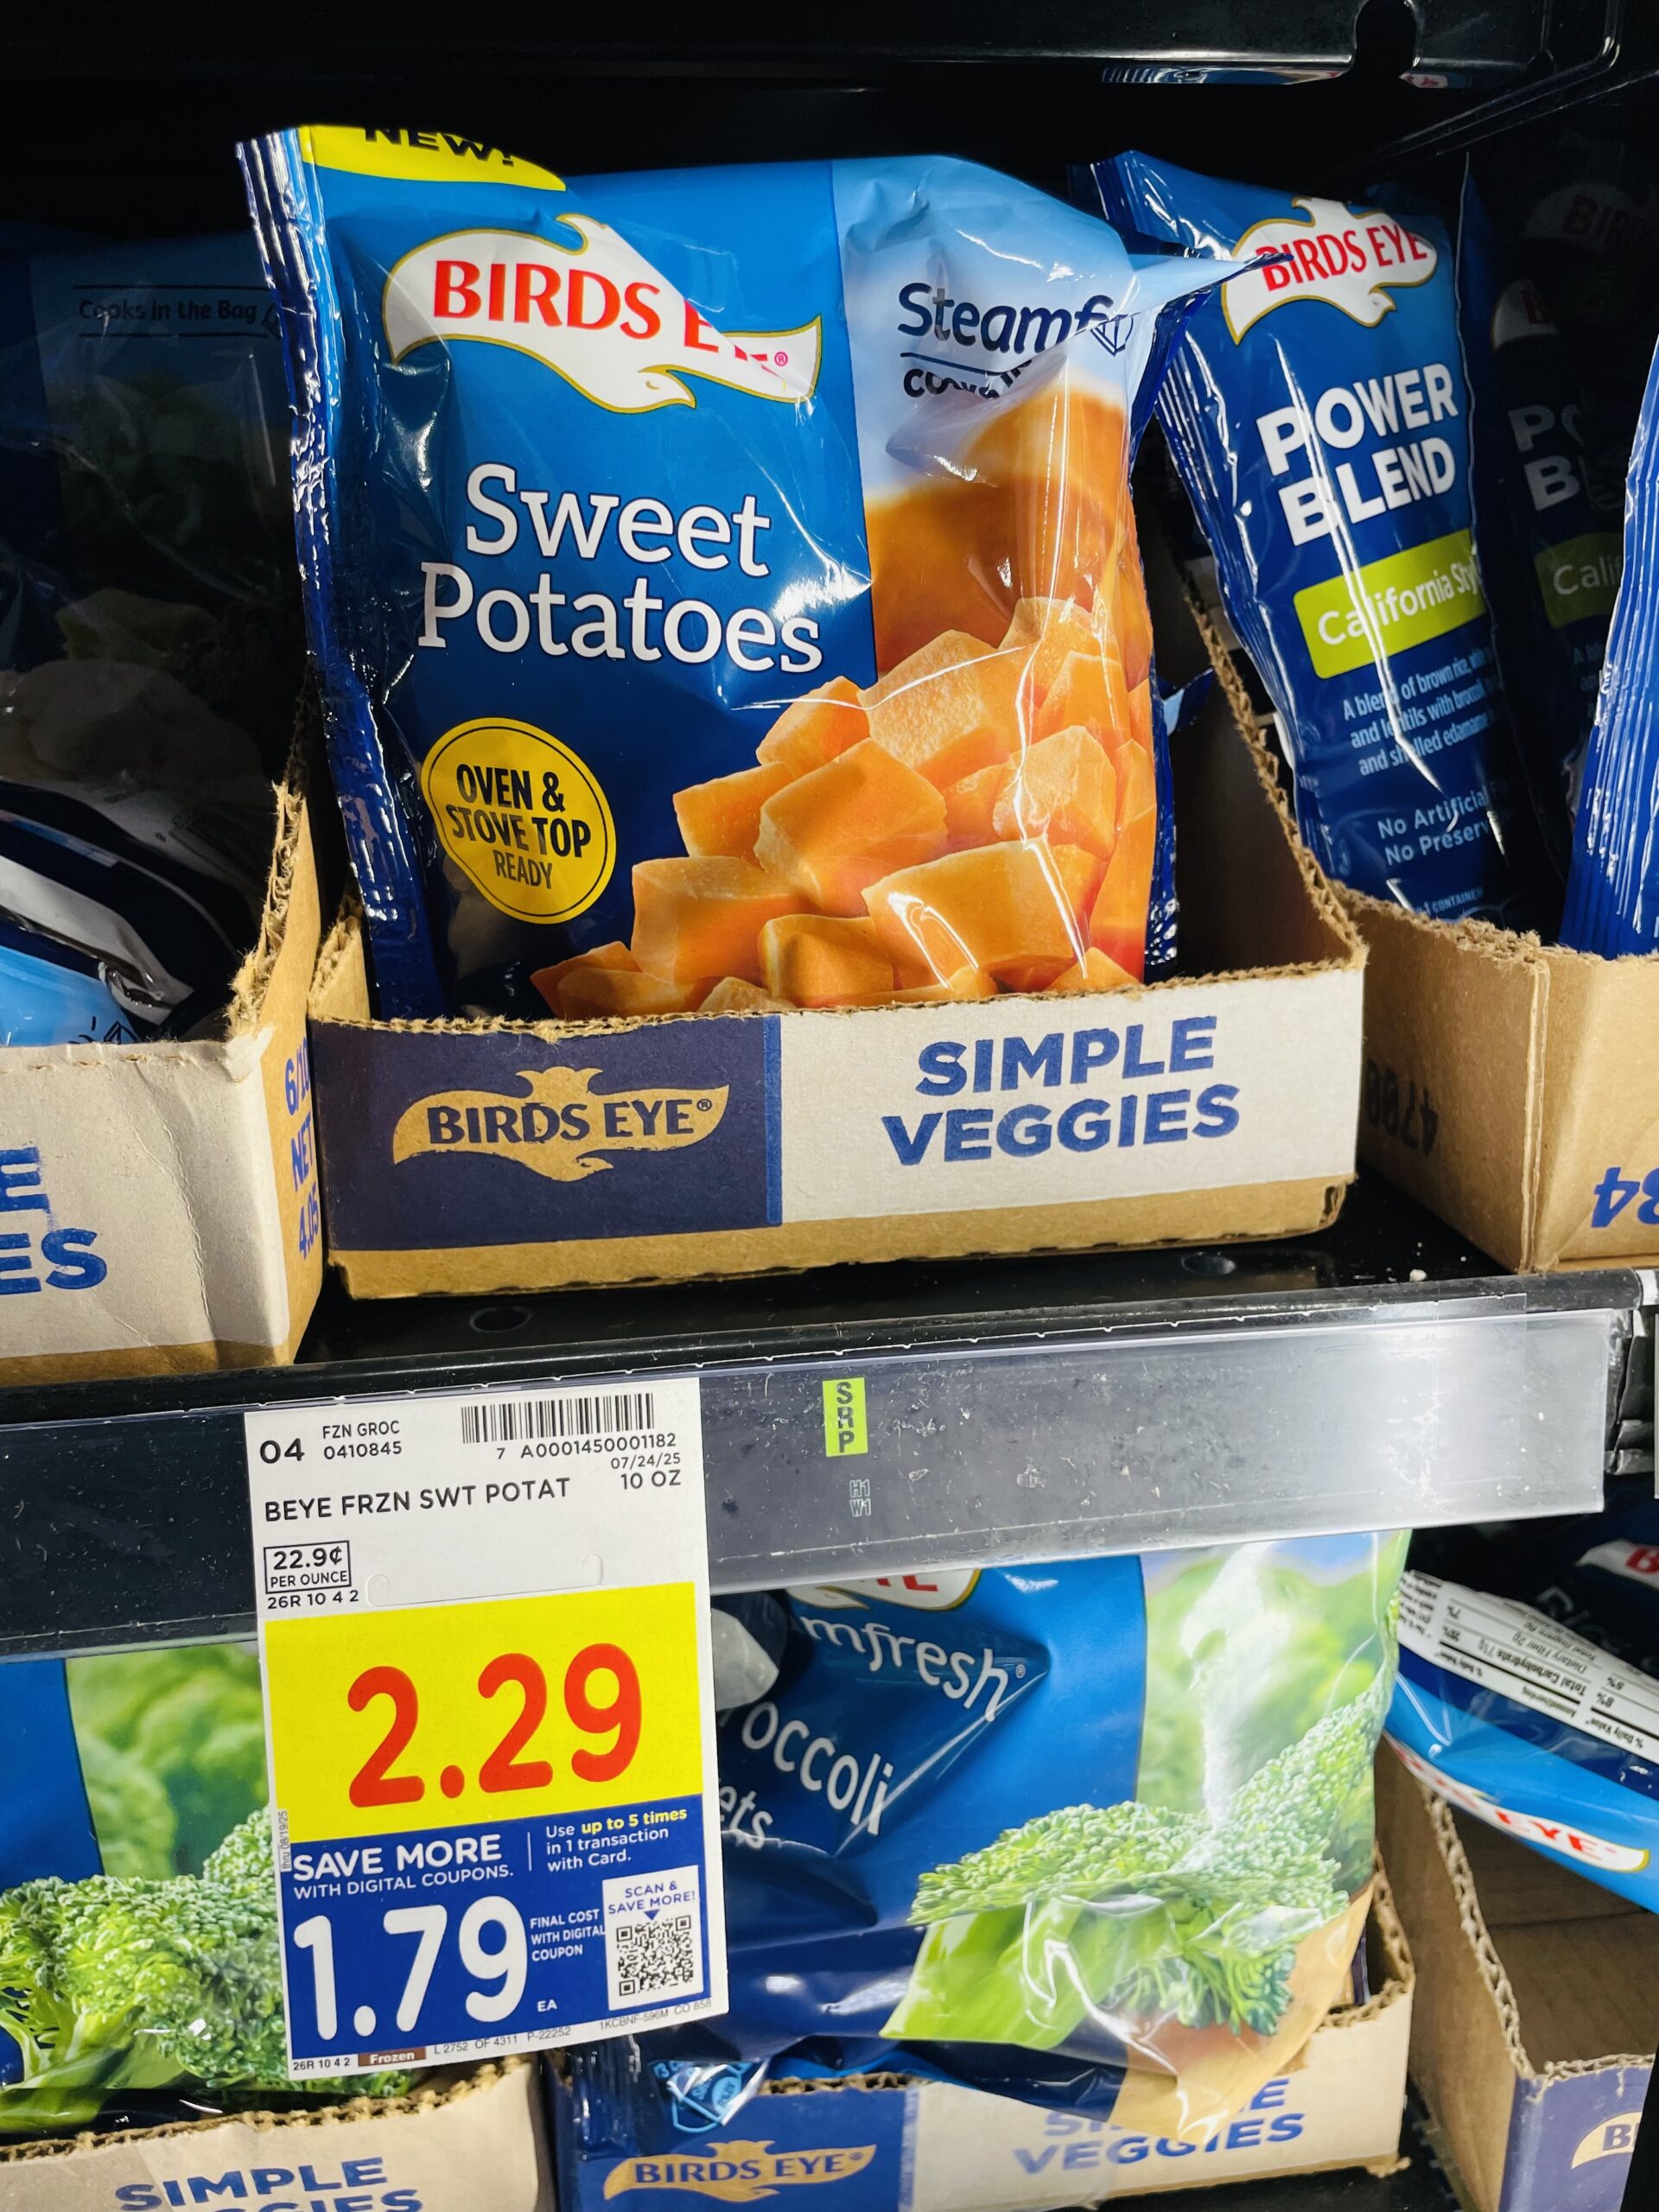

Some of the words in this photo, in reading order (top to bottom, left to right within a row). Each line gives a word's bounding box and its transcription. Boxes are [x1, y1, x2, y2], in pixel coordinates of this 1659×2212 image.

[1255, 229, 1367, 292] BIRDS
[1365, 225, 1428, 267] EYE
[79, 300, 145, 320] Cooks
[178, 300, 212, 320] the
[218, 300, 257, 325] Bag
[434, 259, 662, 340] BIRDS
[898, 282, 1114, 355] Steamf
[1255, 362, 1459, 476] POWER
[1278, 436, 1457, 546] BLEND
[465, 461, 772, 578] Sweet
[417, 561, 822, 674] Potatoes
[1317, 568, 1455, 647] California
[1343, 699, 1357, 721] A
[1356, 683, 1401, 717] blend
[1401, 676, 1417, 701] of
[1416, 663, 1455, 695] brown
[1349, 722, 1382, 749] and
[1426, 693, 1456, 721] with
[1357, 749, 1389, 776] and
[456, 763, 533, 810] OVEN
[541, 771, 567, 813] &
[445, 804, 530, 852] STOVE
[531, 817, 591, 858] TOP
[1376, 817, 1408, 841] No
[1414, 789, 1488, 830] Artificial
[1384, 843, 1414, 866] No
[1418, 818, 1491, 856] Preserv
[493, 849, 553, 890] READY
[915, 1015, 1218, 1097] SIMPLE
[427, 1103, 593, 1146] BIRDS
[880, 1083, 1240, 1167] VEGGIES
[290, 1109, 314, 1193] NET
[259, 1438, 306, 1464] 04
[322, 1423, 353, 1440] FZN
[357, 1420, 401, 1437] GROC
[323, 1440, 403, 1460] 0410845
[496, 1446, 506, 1460] 7
[520, 1432, 677, 1459] A0001450001182
[610, 1452, 682, 1471] 07/24/25
[264, 1496, 333, 1522] BEYE
[341, 1491, 411, 1516] FRZN
[419, 1484, 477, 1510] SWT
[486, 1477, 571, 1504] POTAT
[620, 1472, 644, 1491] 10
[651, 1469, 683, 1489] OZ
[270, 1574, 296, 1589] PER
[300, 1569, 348, 1586] OUNCE
[273, 1545, 343, 1572] 22.9¢
[267, 1596, 302, 1610] 26R
[307, 1592, 327, 1606] 10
[332, 1590, 343, 1605] 4
[349, 1589, 359, 1603] 2
[1552, 1652, 1588, 1675] Dietary
[1560, 1680, 1587, 1697] Total
[347, 1642, 643, 1808] 2.29
[734, 1701, 894, 1836] occoli
[546, 1825, 575, 1839] Use
[581, 1821, 603, 1836] up
[607, 1817, 625, 1831] to
[628, 1814, 639, 1827] 5
[643, 1808, 688, 1825] times
[546, 1841, 562, 1856] in
[566, 1840, 573, 1853] 1
[577, 1827, 670, 1851] transaction
[293, 1847, 385, 1882] SAVE
[396, 1834, 503, 1872] MORE
[547, 1855, 584, 1872] with
[588, 1848, 632, 1867] Card.
[293, 1883, 342, 1900] WITH
[346, 1875, 417, 1895] DIGITAL
[421, 1864, 514, 1887] COUPONS.
[607, 1898, 645, 1915] SAVE
[649, 1890, 696, 1909] MORE!
[624, 1882, 664, 1898] SCAN
[668, 1880, 678, 1891] &
[529, 1915, 566, 1929] FINAL
[568, 1908, 600, 1925] COST
[531, 1929, 562, 1946] WITH
[563, 1923, 606, 1942] DIGITAL
[292, 1894, 529, 2042] 1.79
[531, 1943, 584, 1962] COUPON
[536, 1998, 559, 2013] EA
[674, 2004, 691, 2016] CO
[368, 2049, 416, 2066] Frozen
[434, 2044, 442, 2056] L
[443, 2042, 469, 2055] 2752
[474, 2037, 490, 2050] OF
[493, 2034, 518, 2048] 4311
[526, 2025, 572, 2043] P-22252
[293, 2057, 315, 2072] 26R
[318, 2057, 332, 2070] 10
[334, 2056, 341, 2069] 4
[343, 2056, 351, 2068] 2
[1014, 2113, 1306, 2176] VEGGIES
[115, 2156, 389, 2212] SIMPLE
[634, 2156, 761, 2186] BIRDS
